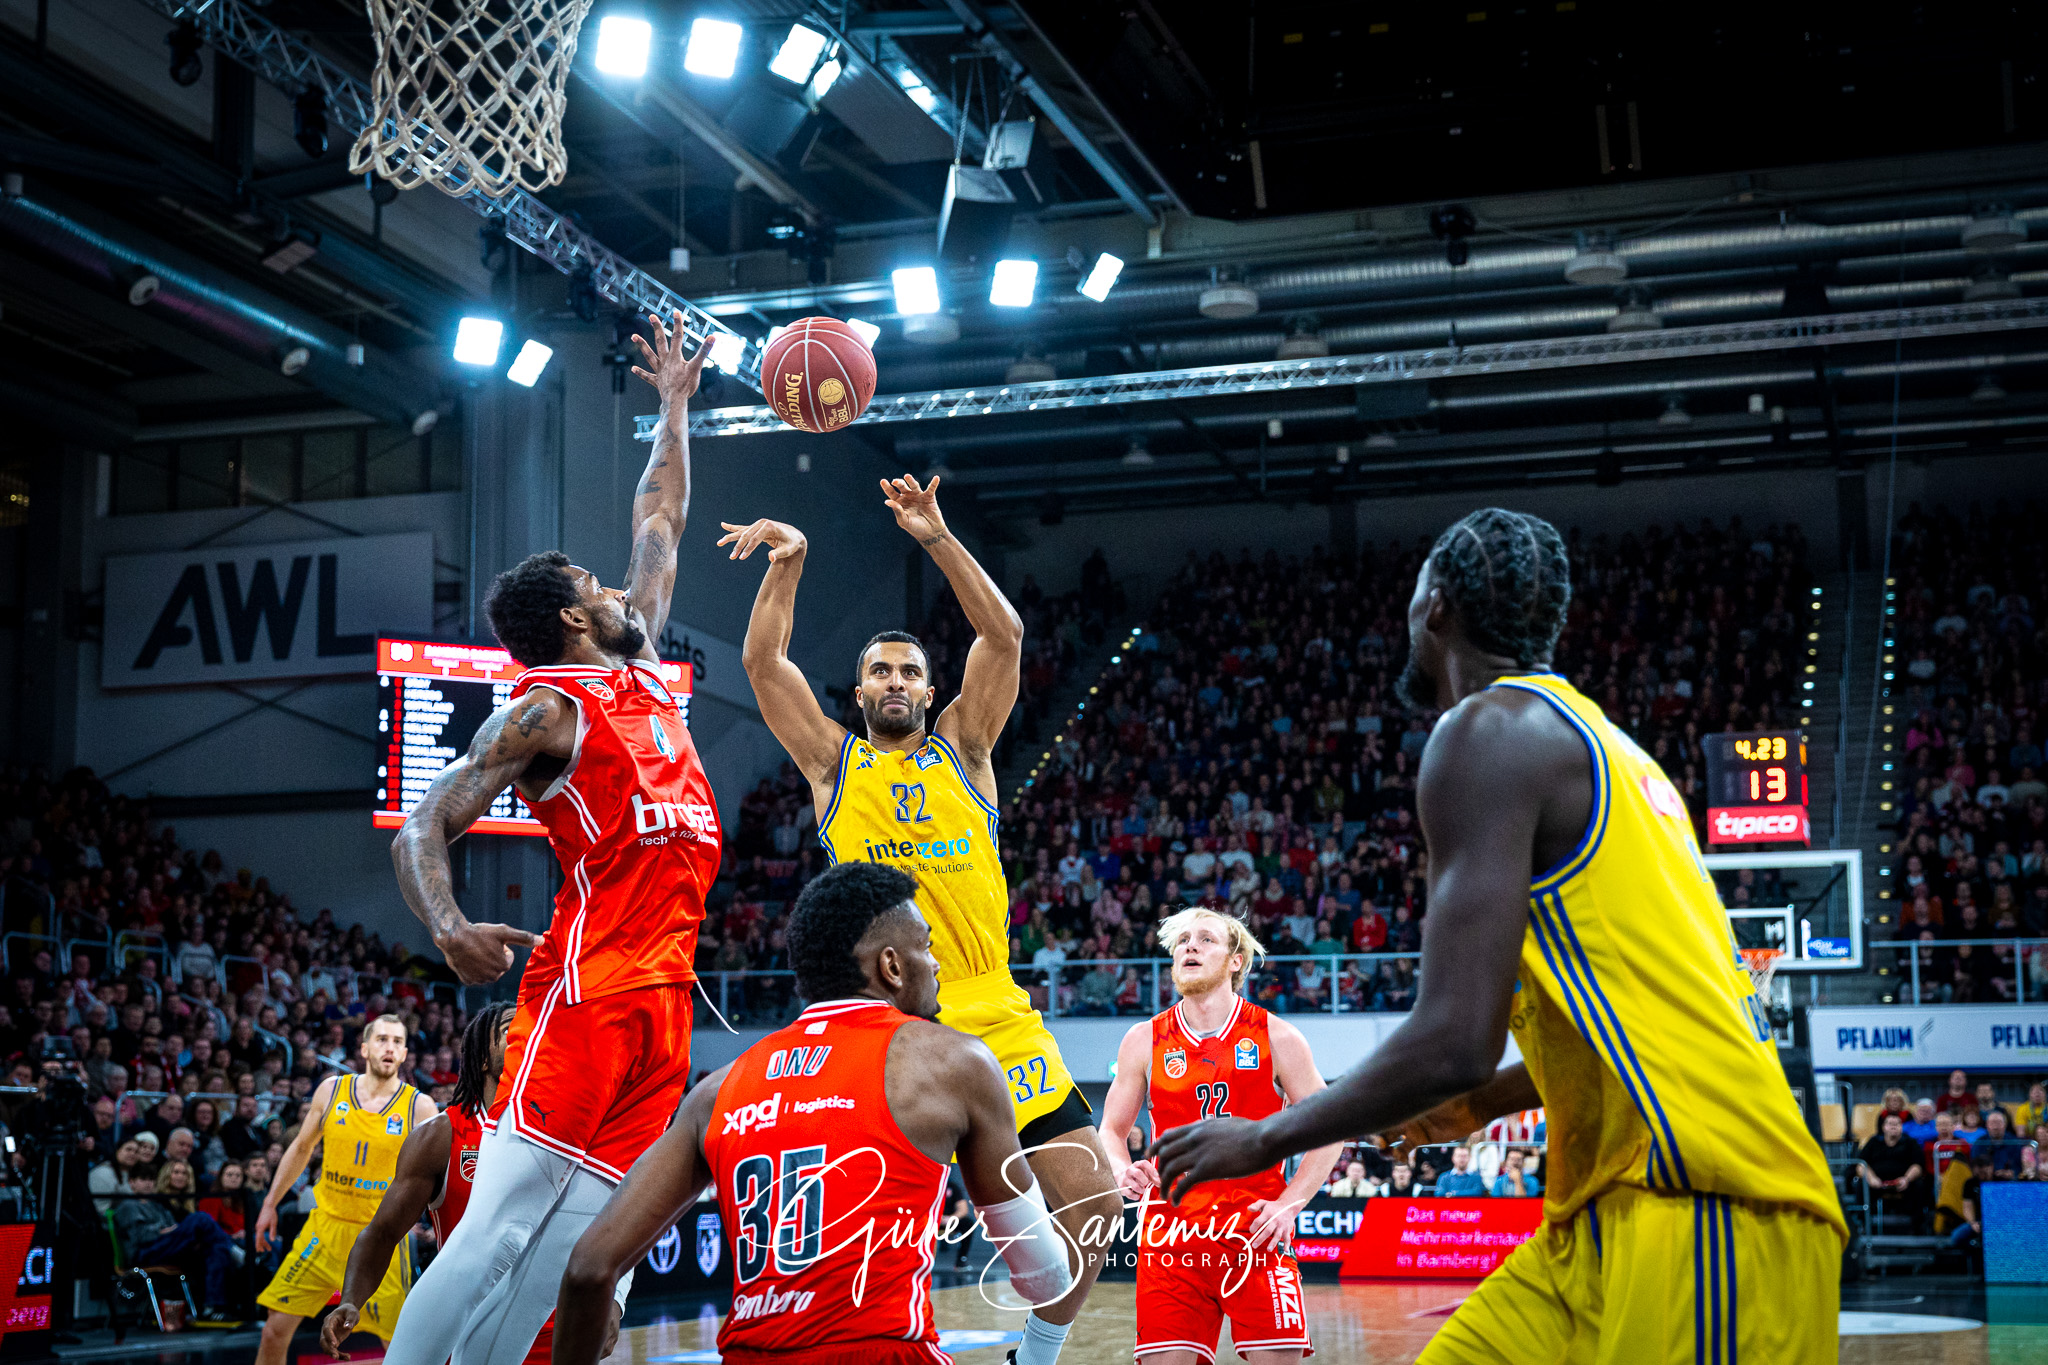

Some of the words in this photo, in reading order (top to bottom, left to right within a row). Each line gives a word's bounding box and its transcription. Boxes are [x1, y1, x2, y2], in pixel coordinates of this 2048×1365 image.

[837, 404, 849, 423] BBL
[131, 554, 375, 670] AWL
[649, 714, 676, 763] 4
[1735, 737, 1787, 761] 4.23
[1750, 767, 1787, 802] 13
[890, 781, 933, 824] 32
[1714, 811, 1798, 840] tipico
[1836, 1026, 1914, 1051] PFLAUM
[1990, 1023, 2048, 1049] PFLAU
[765, 1045, 833, 1080] ONU
[1006, 1055, 1057, 1104] 32
[722, 1092, 782, 1135] xpd
[793, 1095, 855, 1114] logistics
[1195, 1081, 1232, 1120] 22
[354, 1140, 369, 1167] 11
[733, 1144, 825, 1284] 35
[1406, 1206, 1435, 1223] Das
[1440, 1209, 1482, 1223] neue
[1397, 1251, 1413, 1267] in
[1416, 1251, 1498, 1272] Bamberg!
